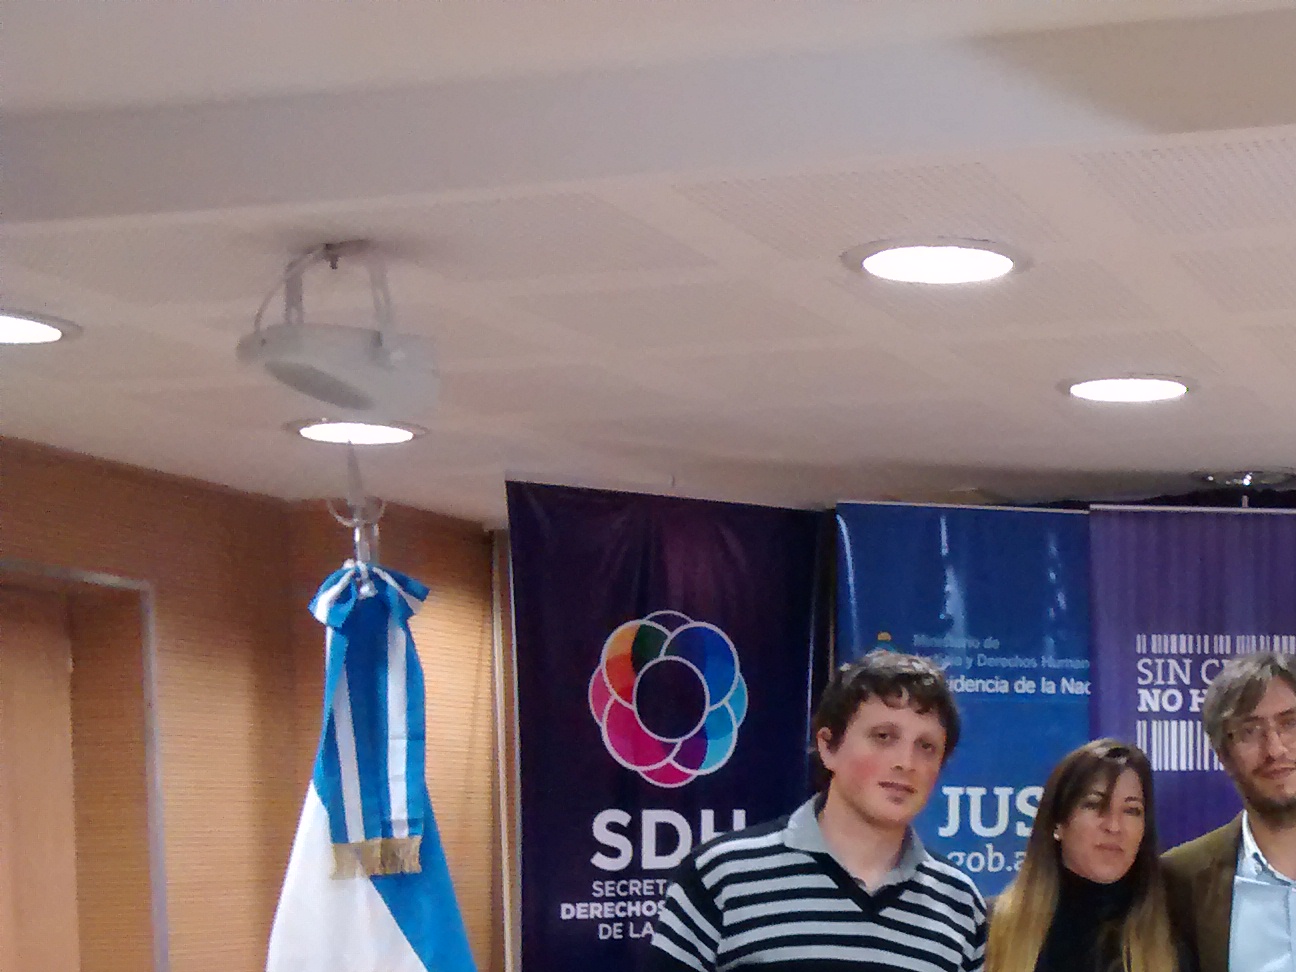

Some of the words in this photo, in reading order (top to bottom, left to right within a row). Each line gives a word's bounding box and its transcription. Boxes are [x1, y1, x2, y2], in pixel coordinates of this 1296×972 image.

[977, 653, 1038, 668] Derechos
[1137, 657, 1192, 686] SIN
[1014, 675, 1036, 694] de
[1041, 676, 1057, 695] la
[1137, 688, 1183, 712] NO
[938, 785, 1045, 838] JUS
[591, 878, 667, 898] SECRET
[598, 923, 624, 940] DE
[629, 921, 656, 939] LA
